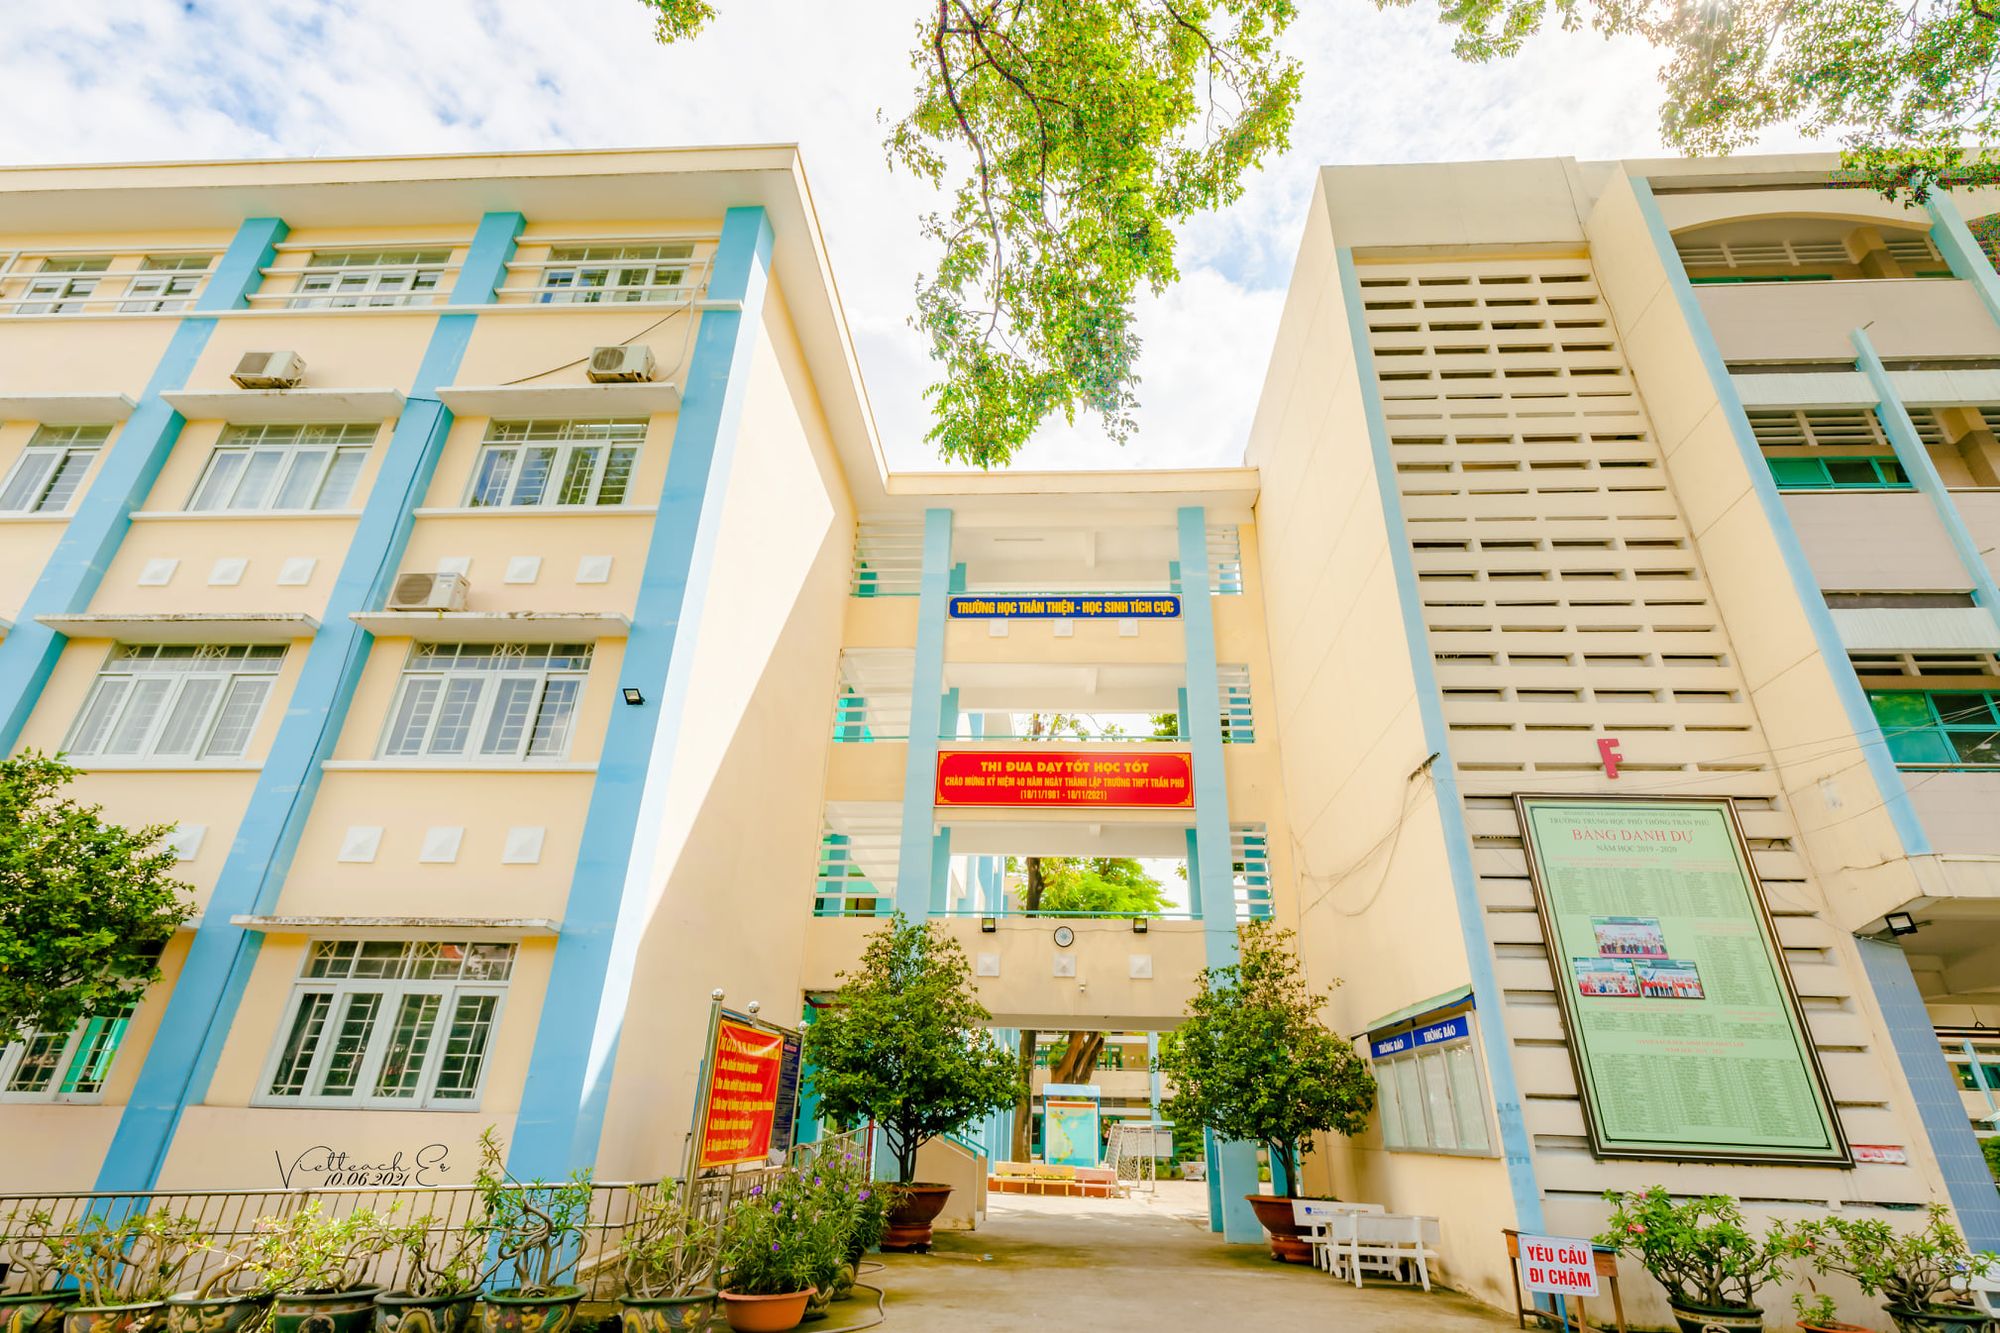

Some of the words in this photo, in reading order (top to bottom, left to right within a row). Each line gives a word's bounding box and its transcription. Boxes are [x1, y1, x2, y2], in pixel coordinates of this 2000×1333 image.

[957, 599, 996, 614] TRƯỜNG
[997, 601, 1017, 616] HỌC
[1018, 599, 1045, 614] THÂN
[1046, 599, 1075, 616] THIỆN
[1082, 601, 1102, 616] HỌC
[1104, 601, 1128, 613] SINH
[1130, 599, 1152, 613] TÍCH
[1153, 600, 1174, 616] CỰC
[981, 761, 1002, 772] THI
[1005, 762, 1033, 772] ĐUA
[1037, 761, 1063, 775] DẠY
[1065, 759, 1090, 773] TỐT
[1094, 762, 1120, 774] HỌC
[1124, 759, 1149, 773] TỐT
[1597, 738, 1624, 779] F
[945, 775, 963, 786] CHÀO
[997, 777, 1015, 788] NIỆM
[1016, 777, 1025, 786] 40
[1044, 775, 1063, 787] NGÀY
[1065, 776, 1087, 788] THÀNH
[1089, 776, 1102, 789] LẬP
[1132, 778, 1149, 788] THPT
[1572, 826, 1617, 841] BẢNG
[1620, 830, 1666, 842] DANH
[1423, 1028, 1443, 1043] THÔNG
[1443, 1024, 1456, 1038] BÁO
[1526, 1243, 1554, 1262] YÊU
[1558, 1244, 1587, 1265] CẦU
[1529, 1267, 1544, 1283] ĐI
[1548, 1267, 1592, 1290] CHẬM
